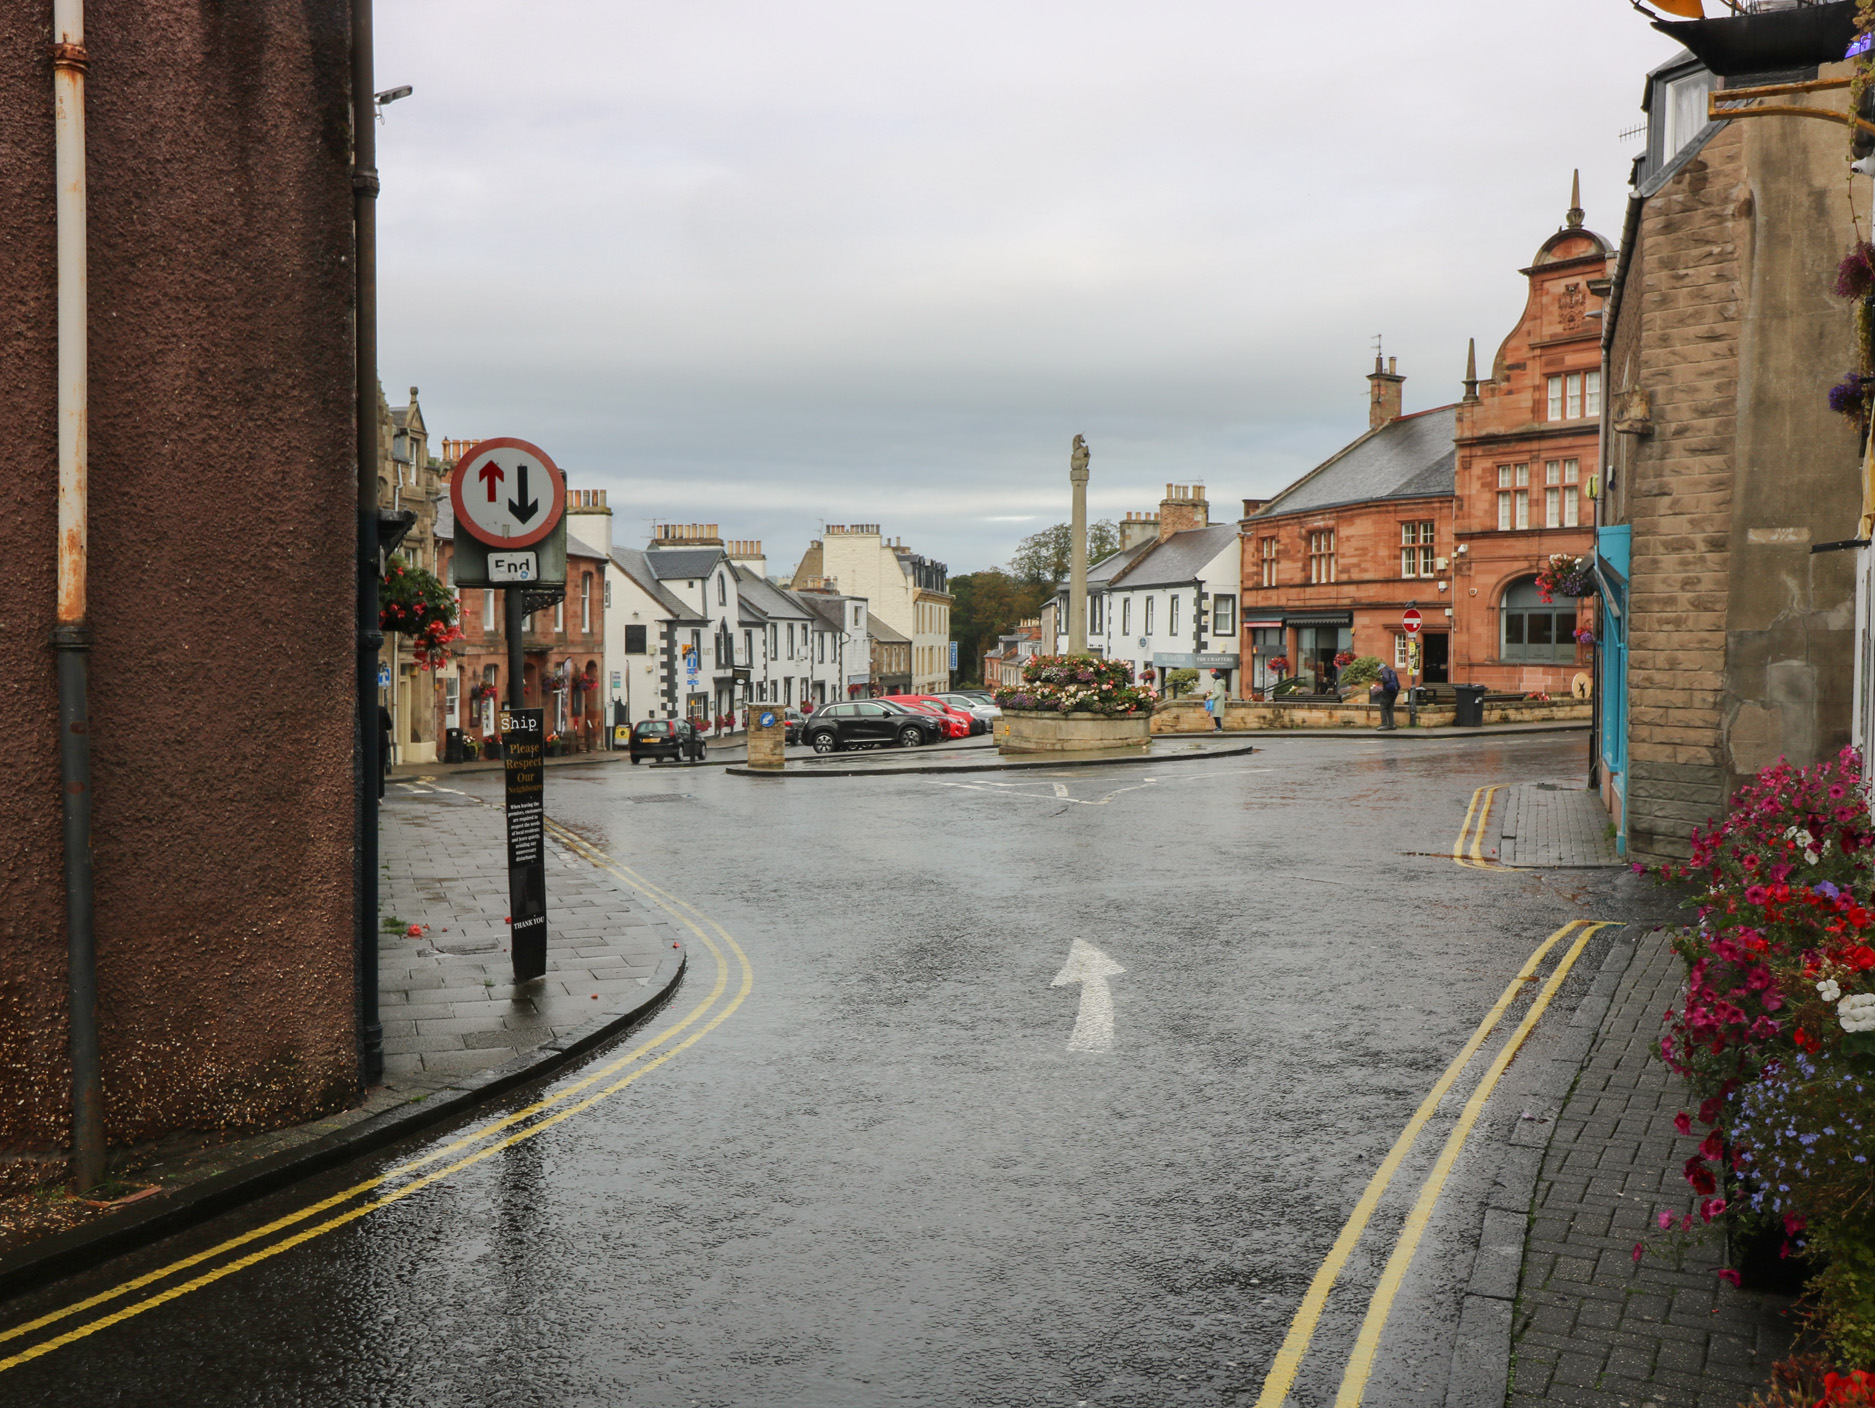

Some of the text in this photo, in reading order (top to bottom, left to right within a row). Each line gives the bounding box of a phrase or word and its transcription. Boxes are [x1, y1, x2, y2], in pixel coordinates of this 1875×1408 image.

[495, 558, 530, 573] End
[501, 716, 536, 731] Ship
[510, 744, 539, 754] Please
[506, 757, 541, 769] Respect
[518, 773, 534, 782] Our
[509, 784, 542, 793] Neighbours
[514, 916, 544, 930] THANK YOU
